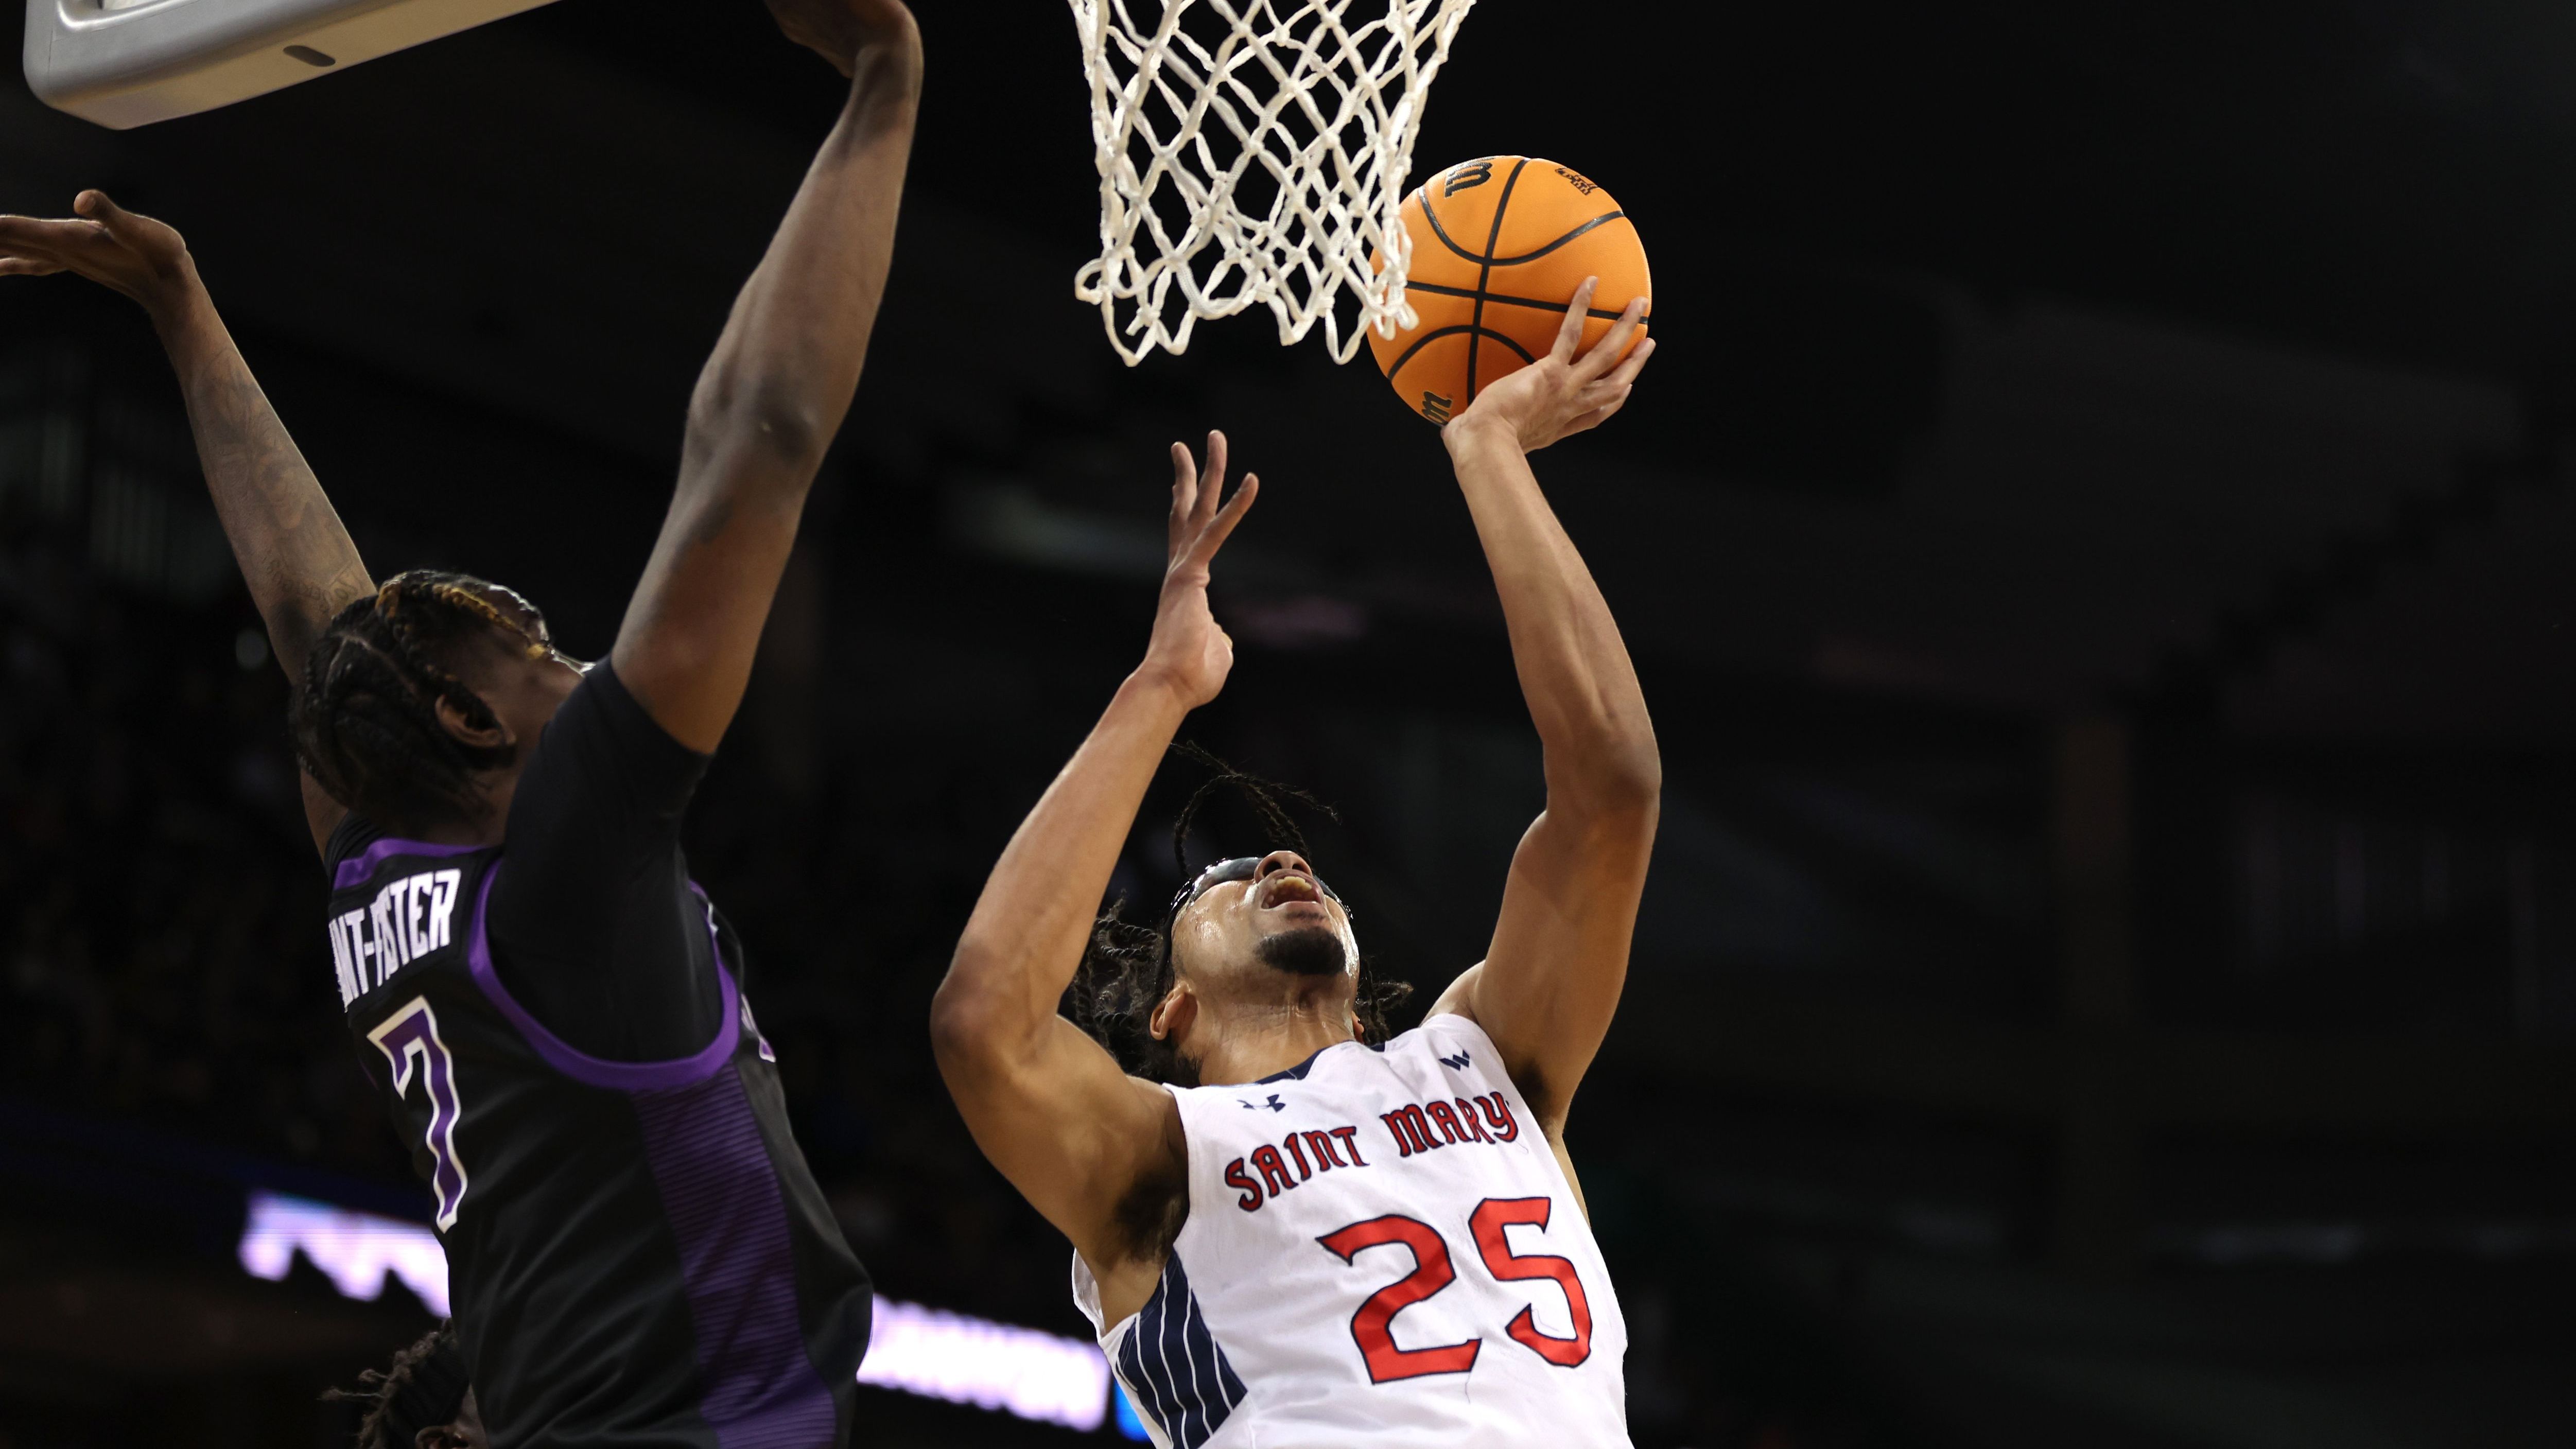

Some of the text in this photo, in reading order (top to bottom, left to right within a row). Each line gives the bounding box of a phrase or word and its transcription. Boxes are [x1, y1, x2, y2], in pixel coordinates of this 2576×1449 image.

[367, 995, 468, 1233] 7
[1224, 1091, 1519, 1212] SAINT MARY
[1316, 1197, 1593, 1385] 25
